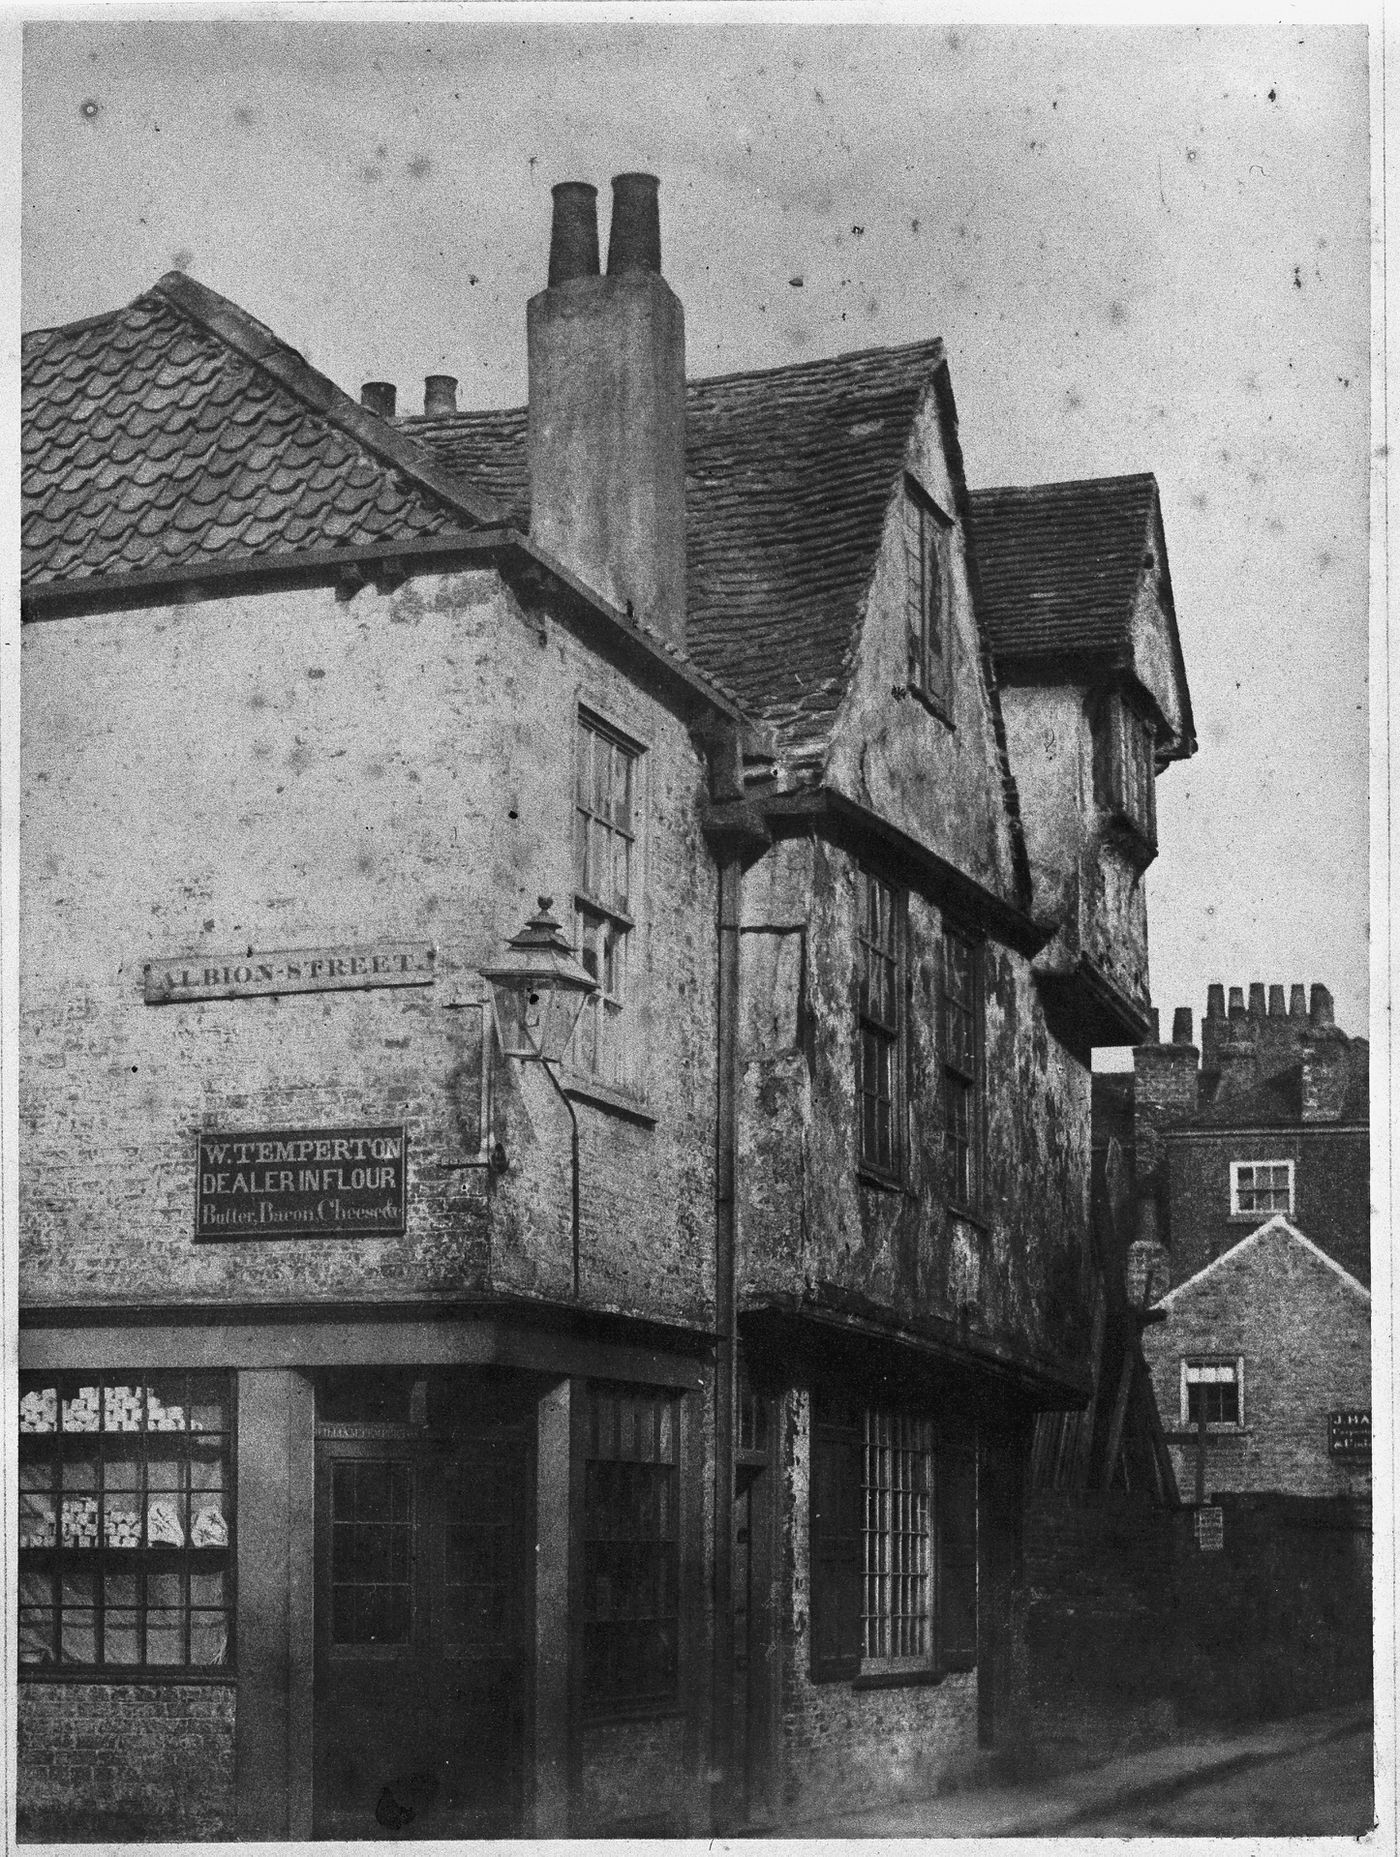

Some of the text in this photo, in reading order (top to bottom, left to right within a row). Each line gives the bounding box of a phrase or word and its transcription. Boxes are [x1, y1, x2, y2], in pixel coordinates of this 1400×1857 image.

[234, 1137, 401, 1163] TEMPERTON
[203, 1166, 396, 1194] DEALER IN FLOUR
